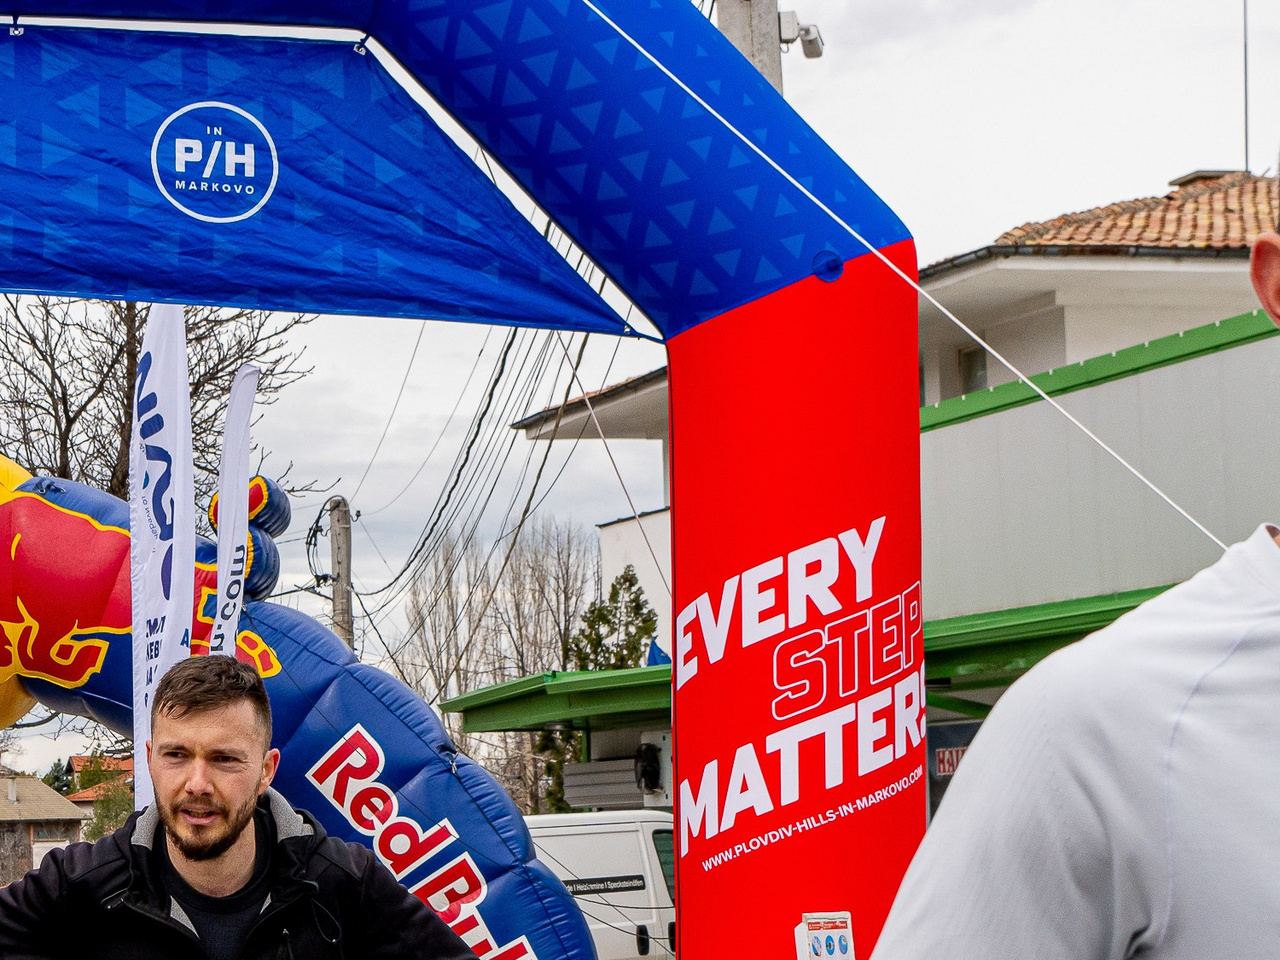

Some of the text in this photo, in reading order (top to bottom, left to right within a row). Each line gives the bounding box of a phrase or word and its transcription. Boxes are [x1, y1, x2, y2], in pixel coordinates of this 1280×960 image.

[175, 137, 255, 178] P/H
[206, 125, 222, 136] IN
[175, 180, 255, 195] MARKOVO
[676, 515, 887, 691] EVERY
[772, 580, 922, 721] STEP
[308, 727, 455, 878] Red
[702, 765, 923, 873] WWW.PLOVDIV-HILLS-IN-MARKOVO.COM
